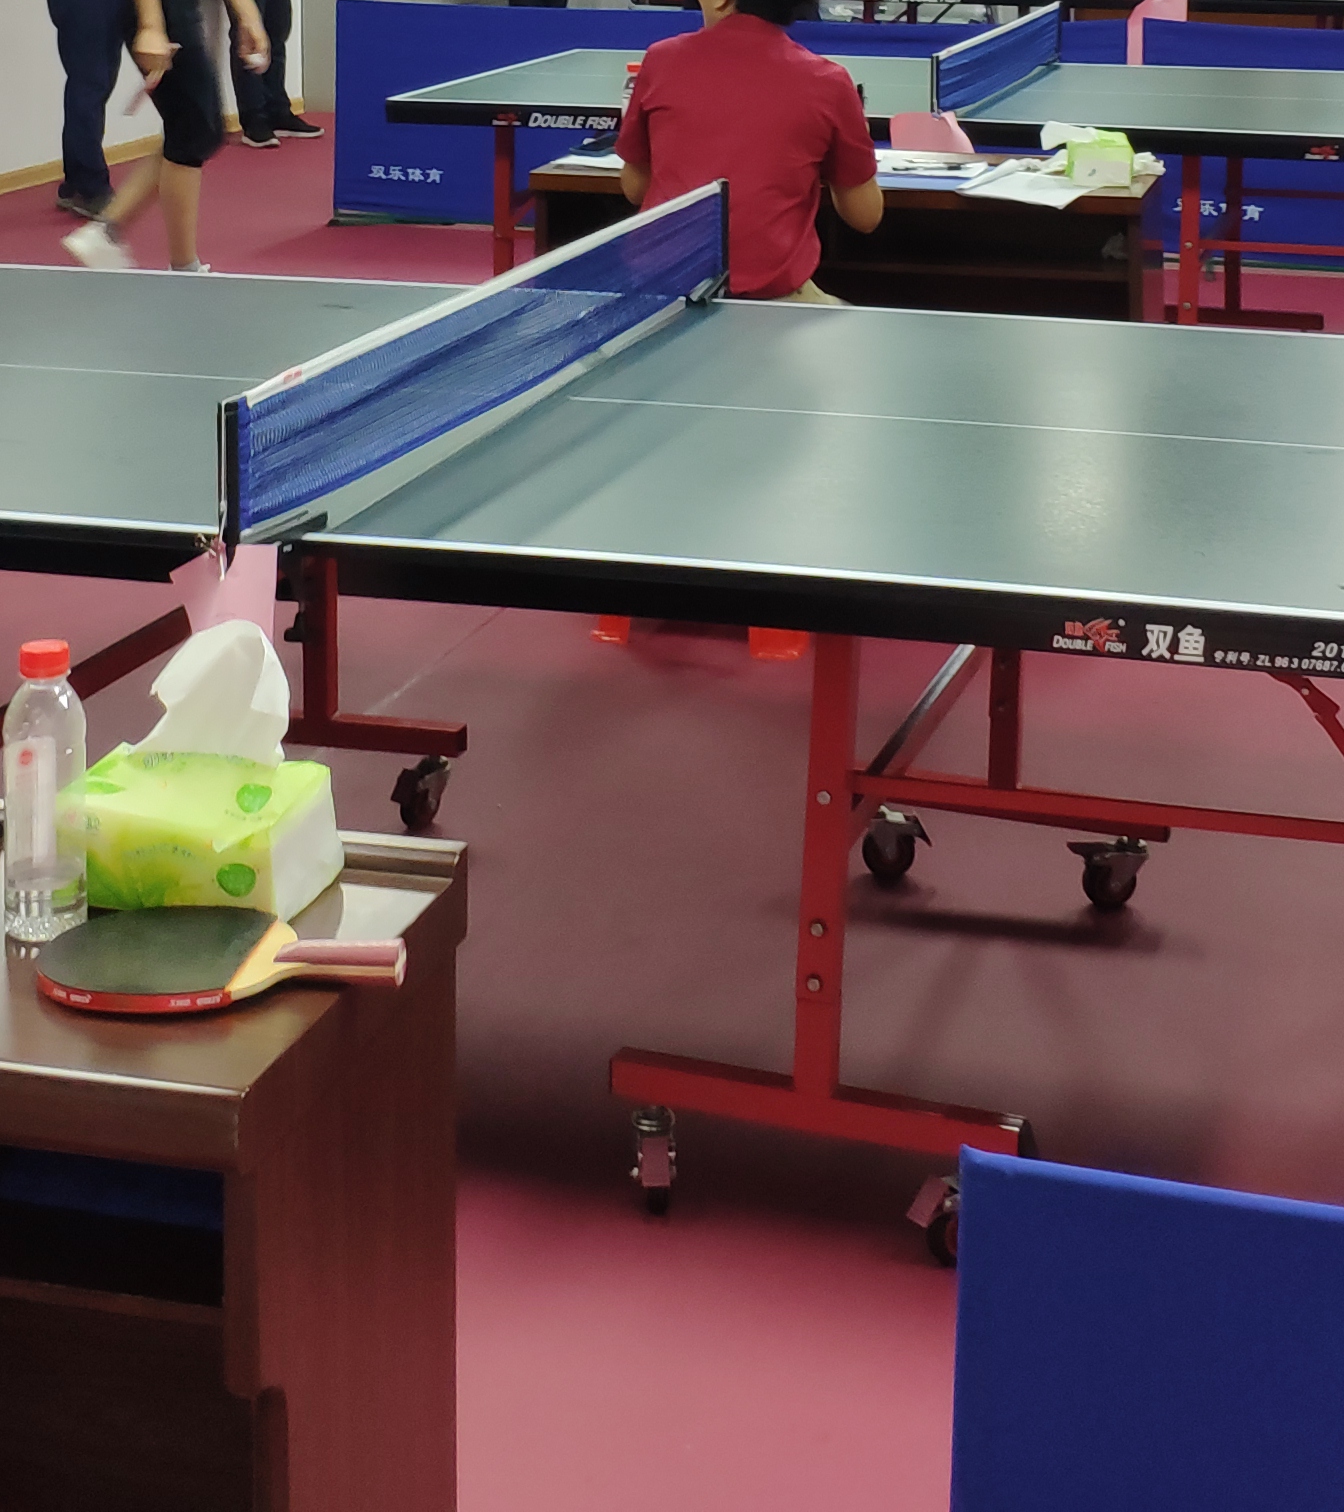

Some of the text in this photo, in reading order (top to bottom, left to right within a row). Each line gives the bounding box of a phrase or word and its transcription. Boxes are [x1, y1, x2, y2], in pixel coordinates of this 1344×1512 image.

[529, 113, 584, 128] DOUBLE
[584, 117, 618, 130] FISH
[1141, 624, 1205, 663] 双鱼
[1256, 654, 1271, 666] ZL
